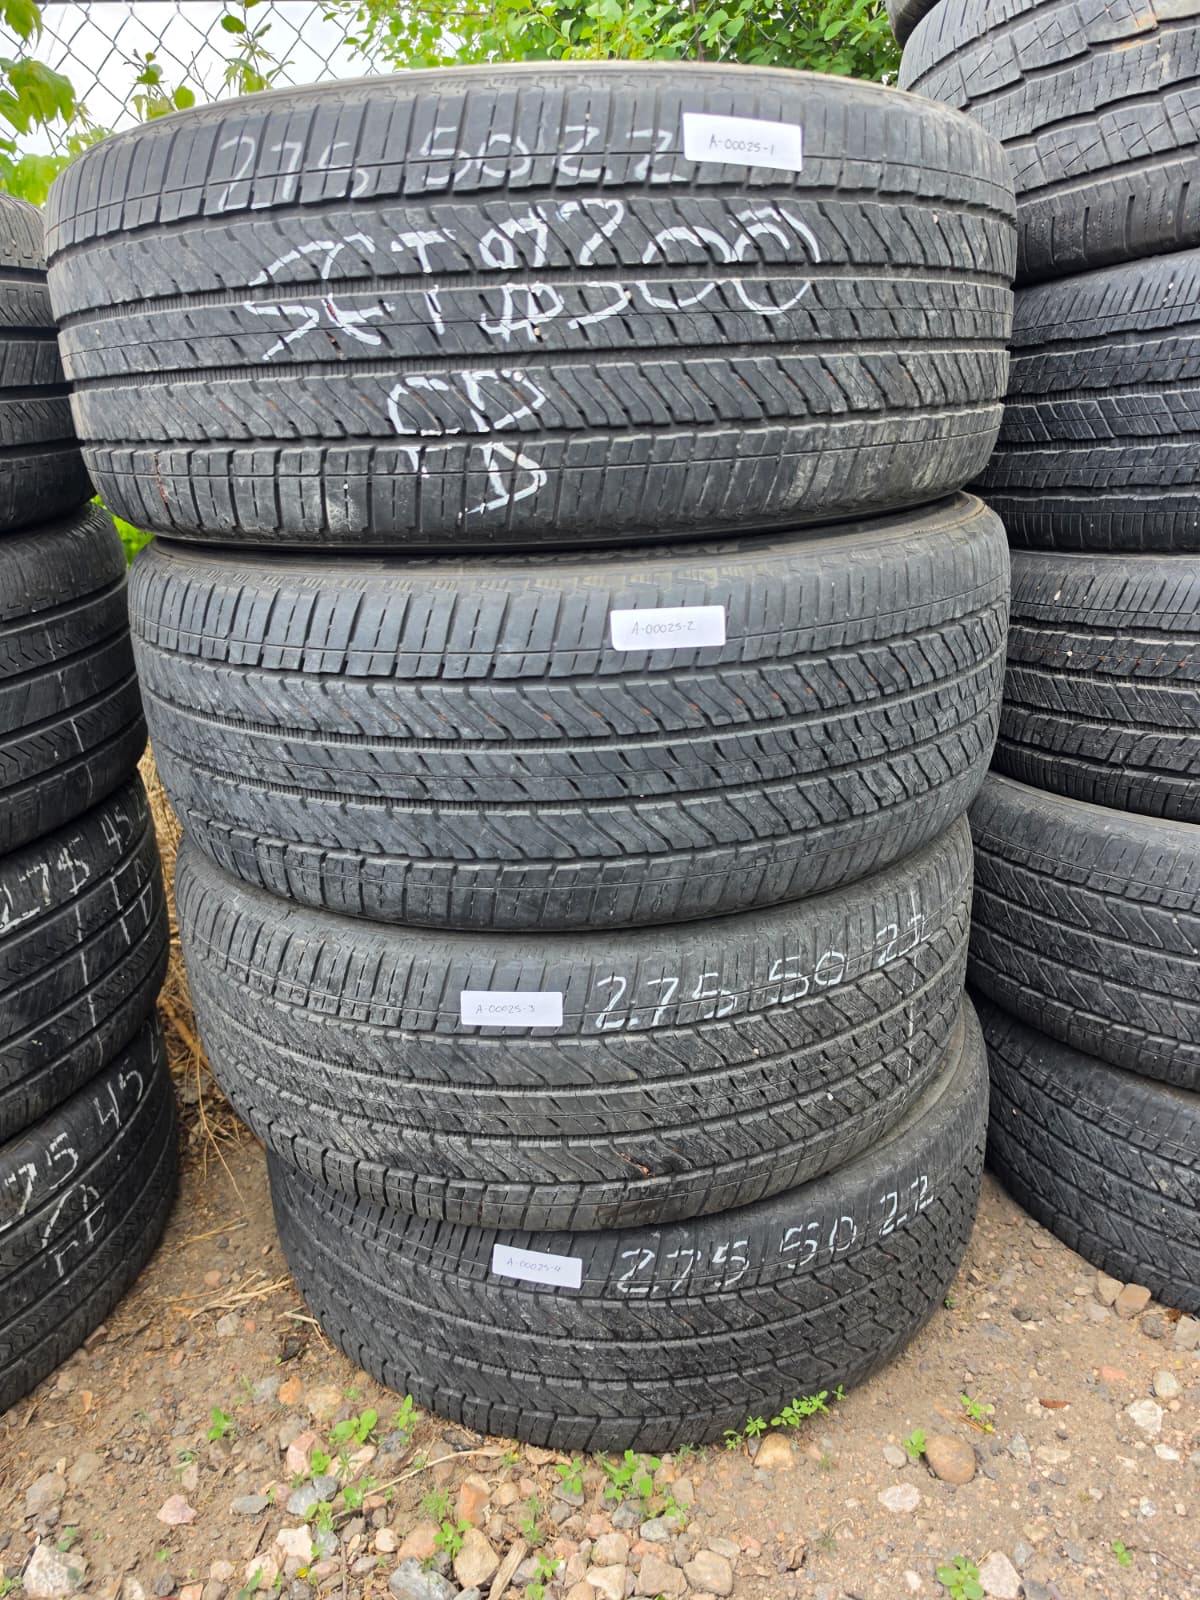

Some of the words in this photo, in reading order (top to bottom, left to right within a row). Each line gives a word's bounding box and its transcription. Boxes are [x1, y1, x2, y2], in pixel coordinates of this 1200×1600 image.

[219, 135, 370, 212] 275
[709, 133, 775, 156] A-00025-1
[631, 621, 697, 636] A-00025-2
[595, 971, 739, 1030] 275
[769, 950, 846, 1005] 50
[0, 1131, 79, 1232] 75
[616, 1239, 750, 1293] 275
[780, 1220, 857, 1270] 50
[880, 1175, 934, 1236] 22
